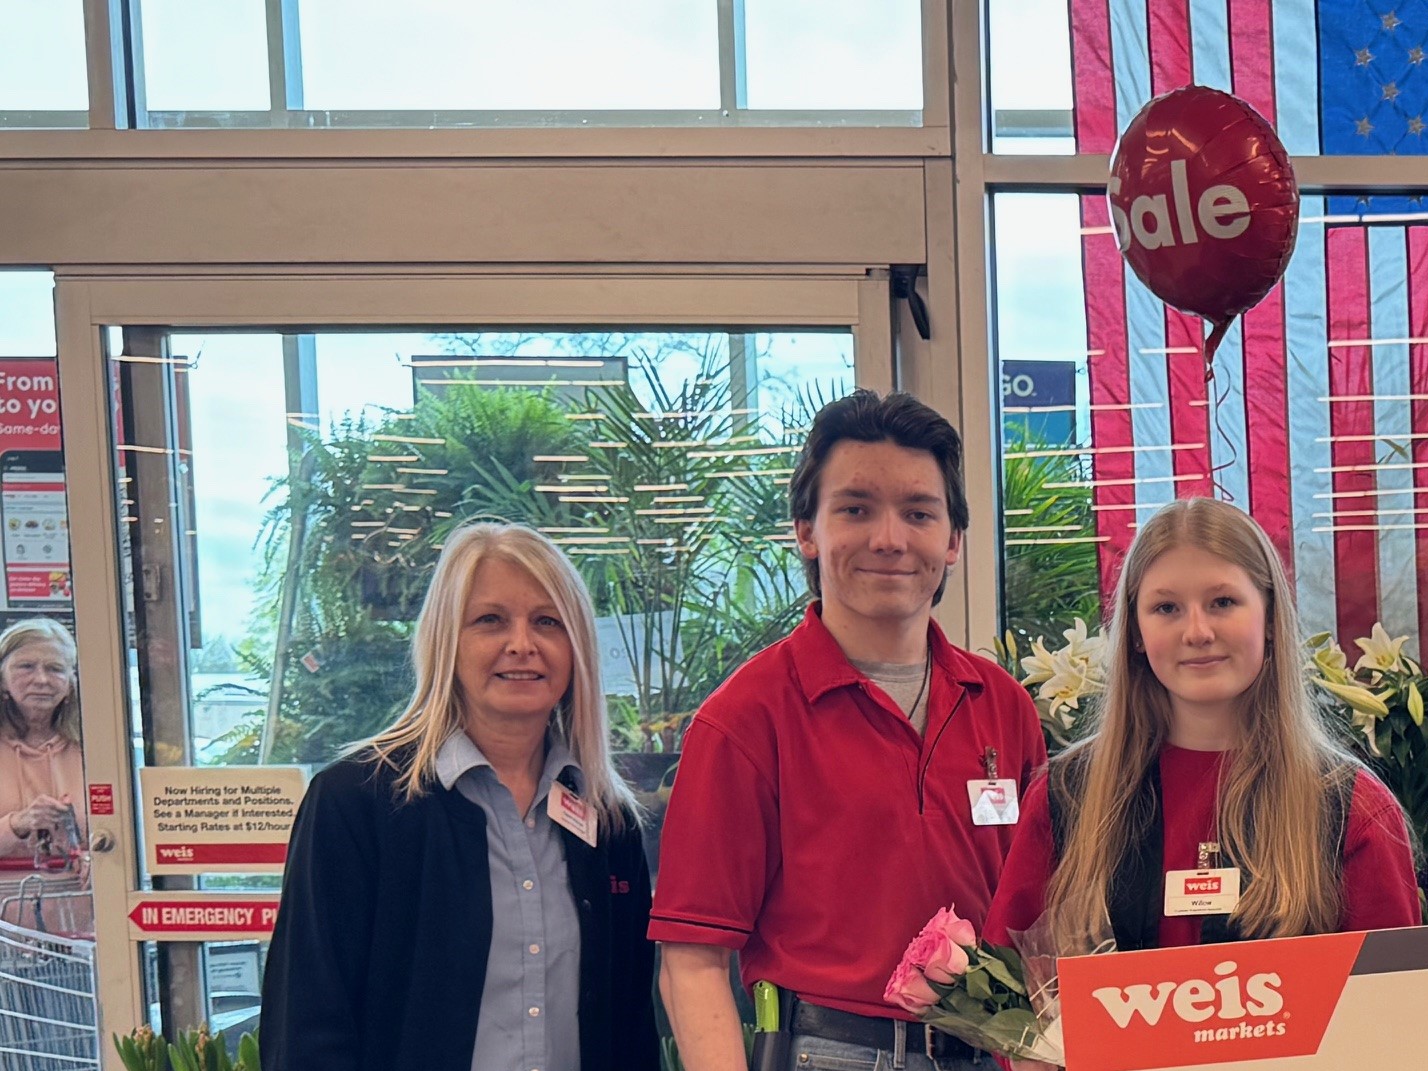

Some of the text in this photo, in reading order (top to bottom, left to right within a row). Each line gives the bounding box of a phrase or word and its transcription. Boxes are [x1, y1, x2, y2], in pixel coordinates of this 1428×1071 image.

[0, 398, 21, 414] to
[165, 786, 282, 797] Now Hiring for Multiple
[153, 797, 295, 807] Departments and Positions.
[153, 810, 173, 818] See
[184, 810, 229, 819] Manager
[232, 810, 239, 818] if
[157, 822, 291, 833] Starting Rates at $12/hour
[160, 846, 194, 858] weis
[1186, 880, 1219, 891] weis
[142, 908, 158, 925] IN
[161, 907, 254, 925] EMERGENCY
[1092, 960, 1284, 1029] weis
[1193, 1020, 1286, 1043] markets
